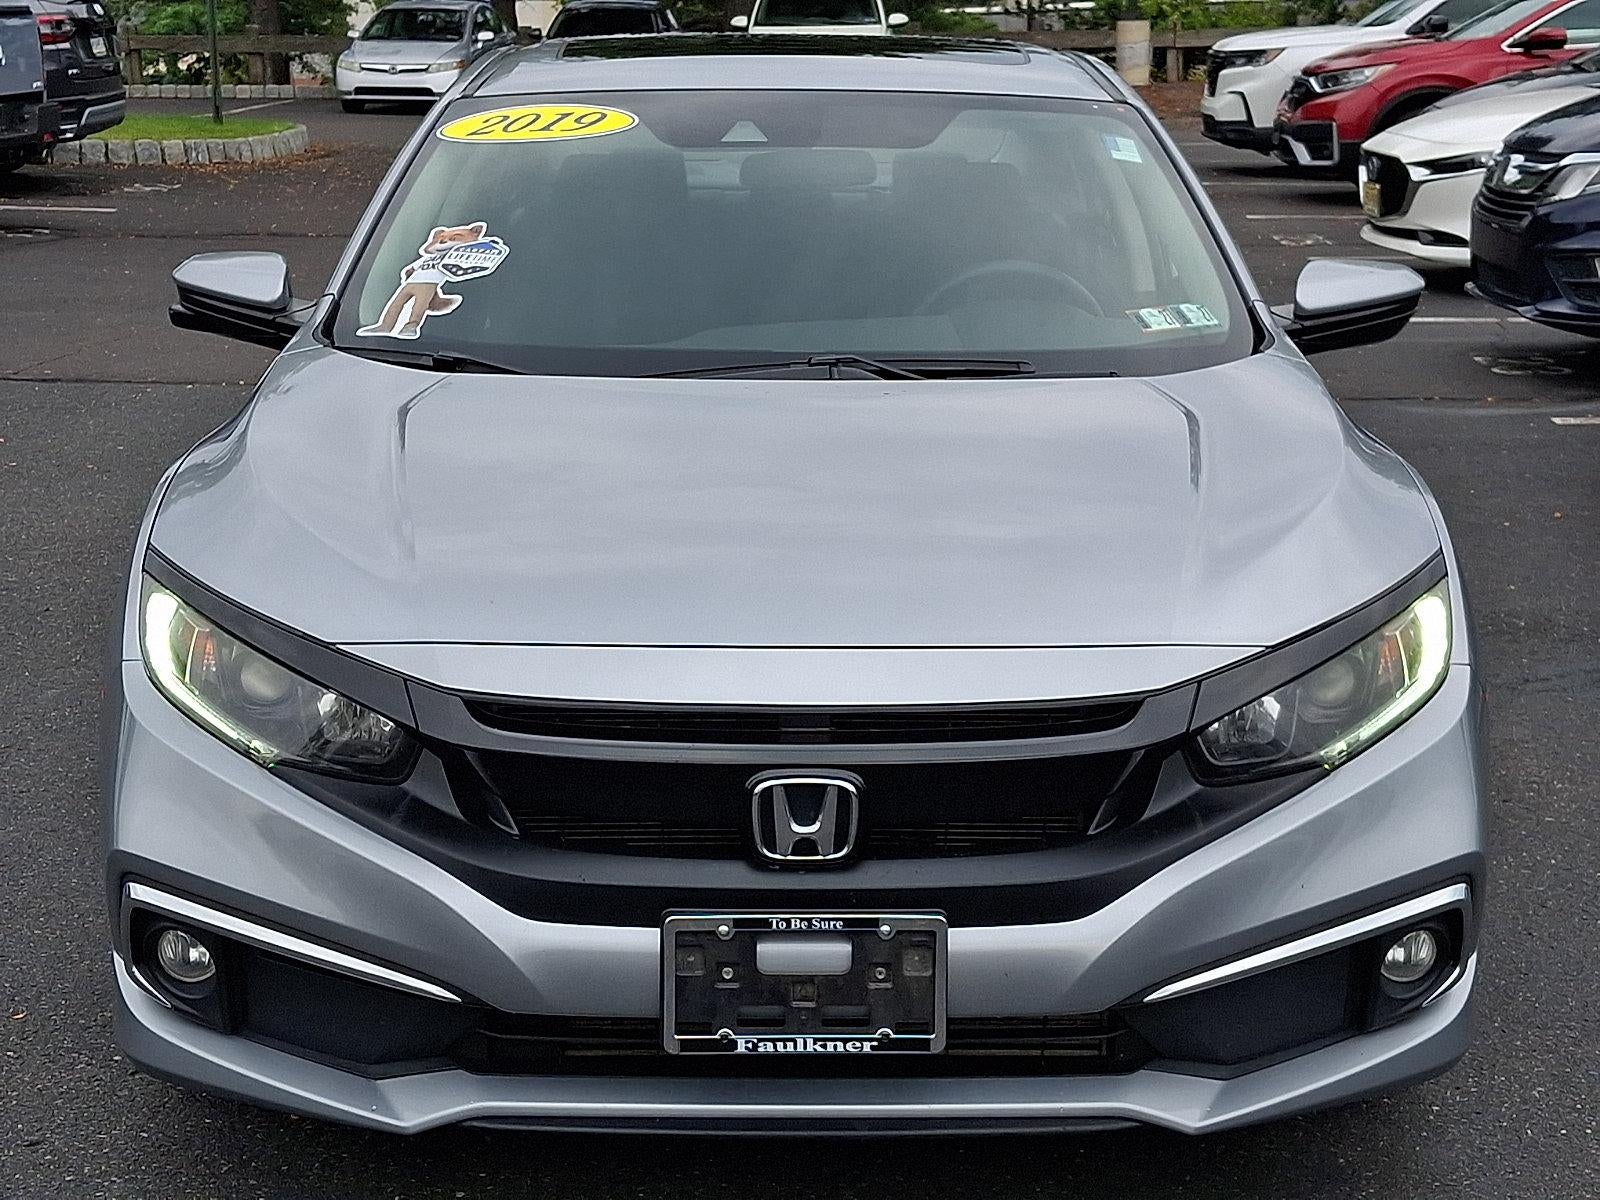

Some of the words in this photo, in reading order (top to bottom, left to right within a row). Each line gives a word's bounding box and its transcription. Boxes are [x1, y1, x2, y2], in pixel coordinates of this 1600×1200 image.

[465, 111, 608, 137] 2019
[447, 252, 497, 263] LIFETIME
[769, 918, 787, 930] To
[790, 918, 809, 930] Be
[811, 918, 844, 930] Sure
[735, 1037, 879, 1052] Faulkner
